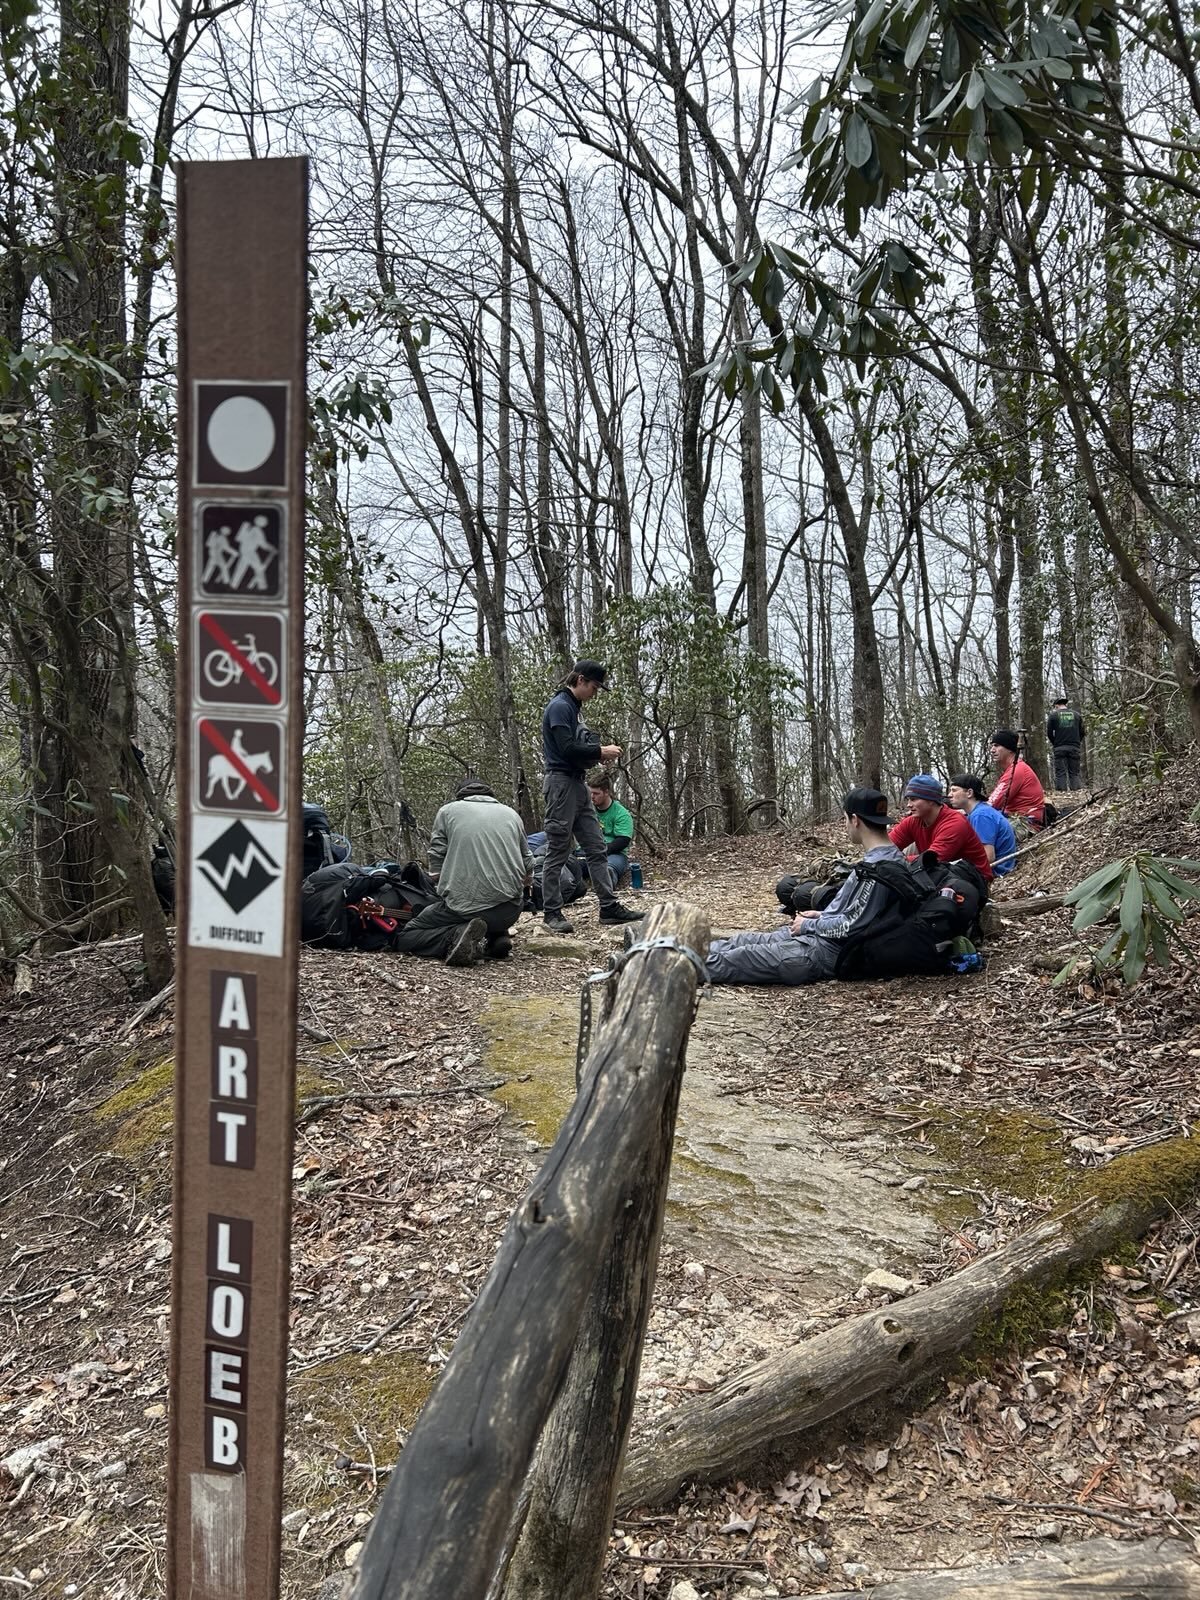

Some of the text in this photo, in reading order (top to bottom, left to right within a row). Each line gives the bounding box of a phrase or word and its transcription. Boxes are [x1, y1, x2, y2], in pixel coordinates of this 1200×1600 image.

[209, 924, 264, 944] DIFFICULT
[210, 976, 251, 1467] ART LOEB
